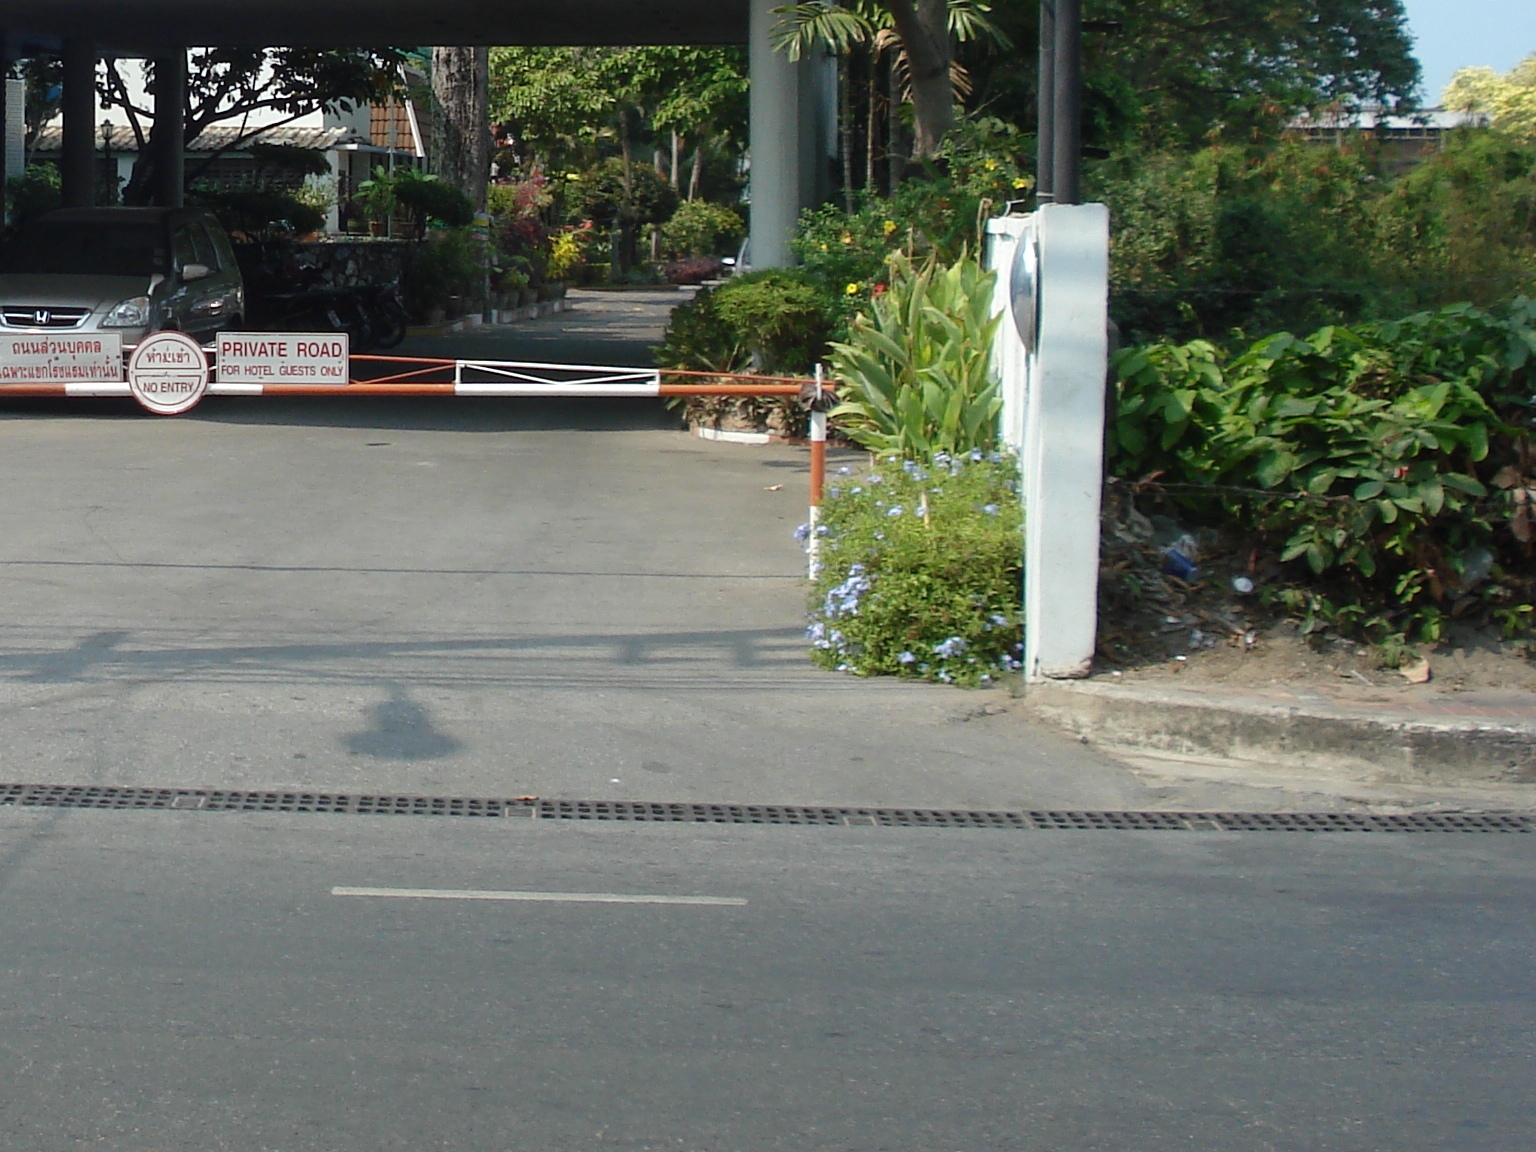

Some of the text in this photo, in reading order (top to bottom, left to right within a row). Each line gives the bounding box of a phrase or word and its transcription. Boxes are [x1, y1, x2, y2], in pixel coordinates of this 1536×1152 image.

[12, 337, 102, 361] ถนนส่วนบุคคล
[222, 342, 342, 358] PRIVATE ROAD
[221, 365, 343, 376] FOR HOTEL GUESTS ONLY
[144, 382, 194, 393] NO ENTRY
